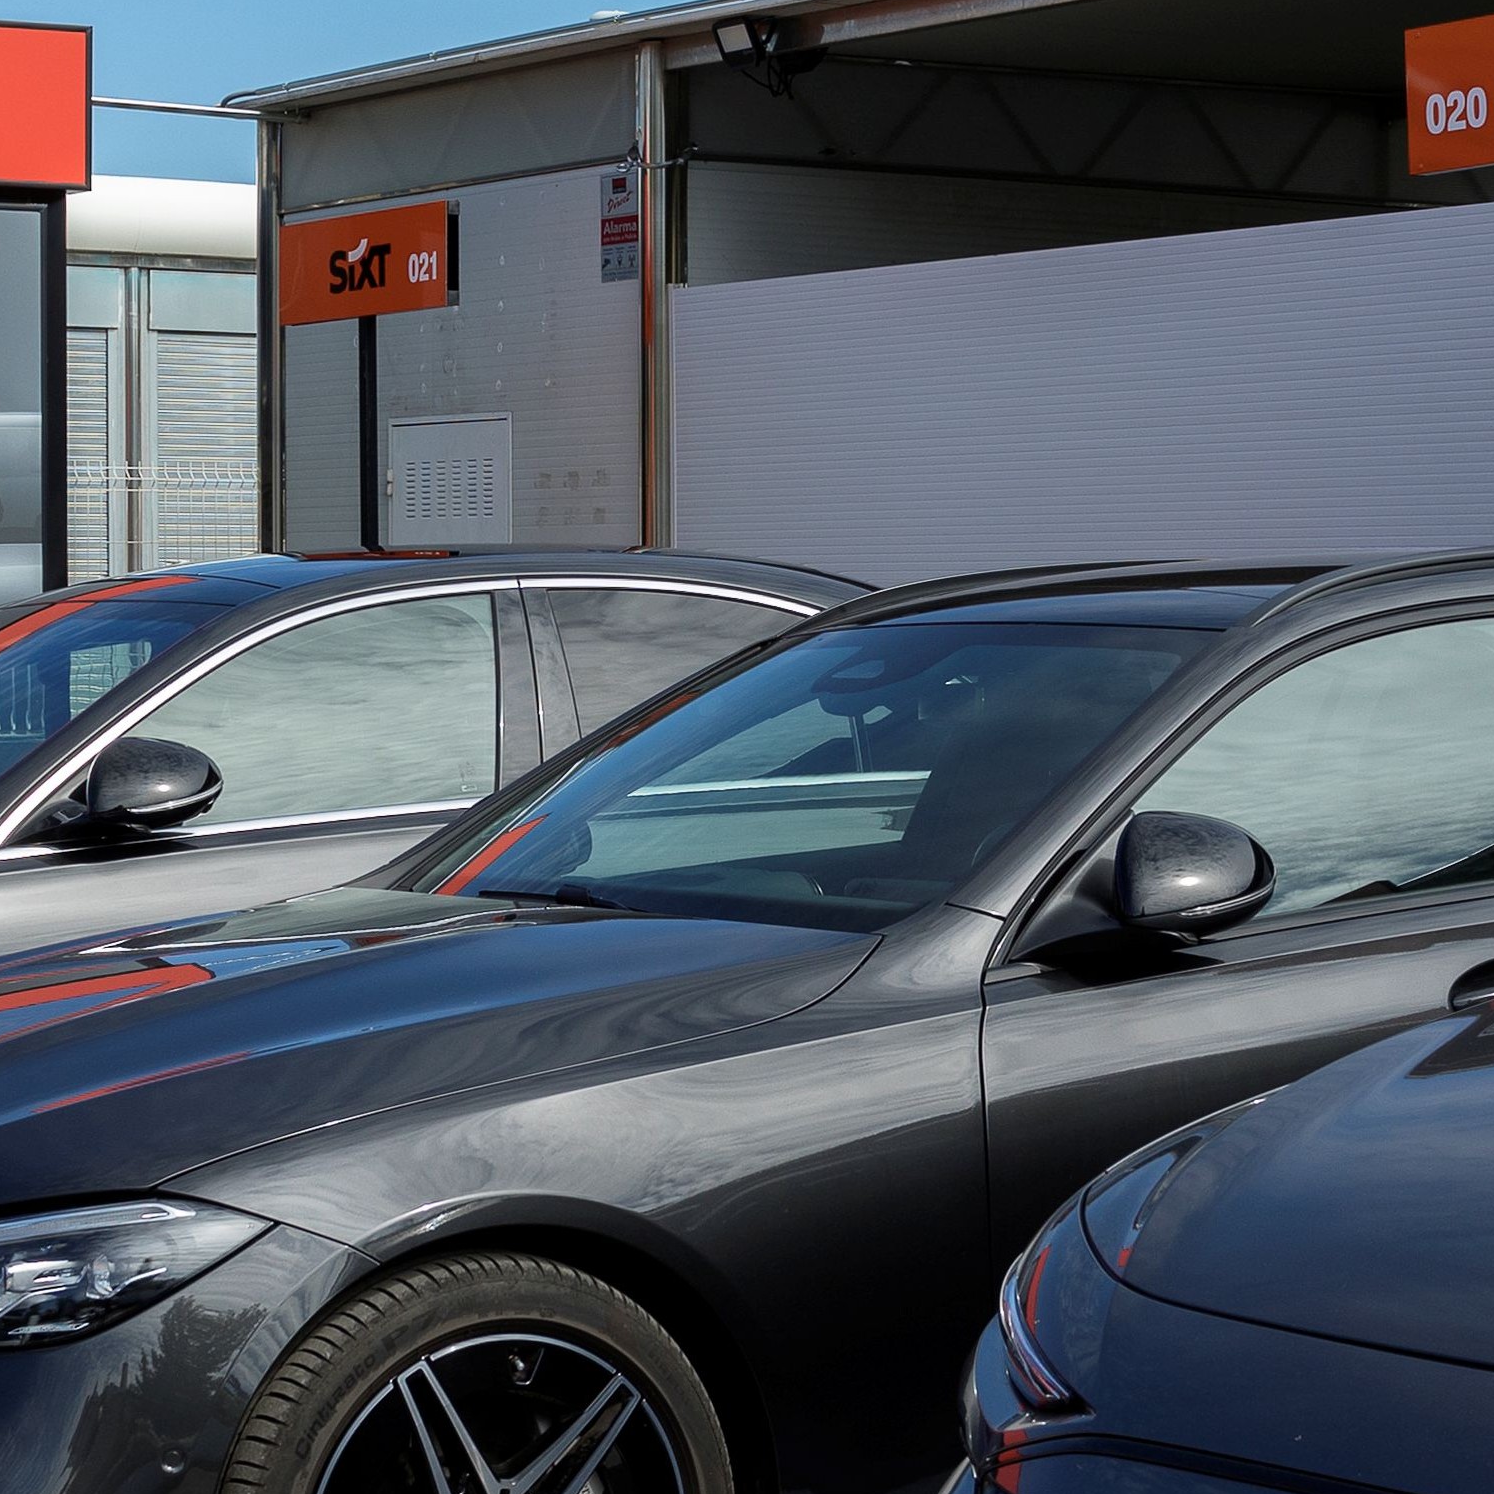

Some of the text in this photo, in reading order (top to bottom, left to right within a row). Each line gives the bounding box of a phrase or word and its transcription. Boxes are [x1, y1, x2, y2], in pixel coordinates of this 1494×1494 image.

[1425, 86, 1488, 135] 020
[603, 220, 638, 235] Alarma
[408, 250, 438, 283] 021
